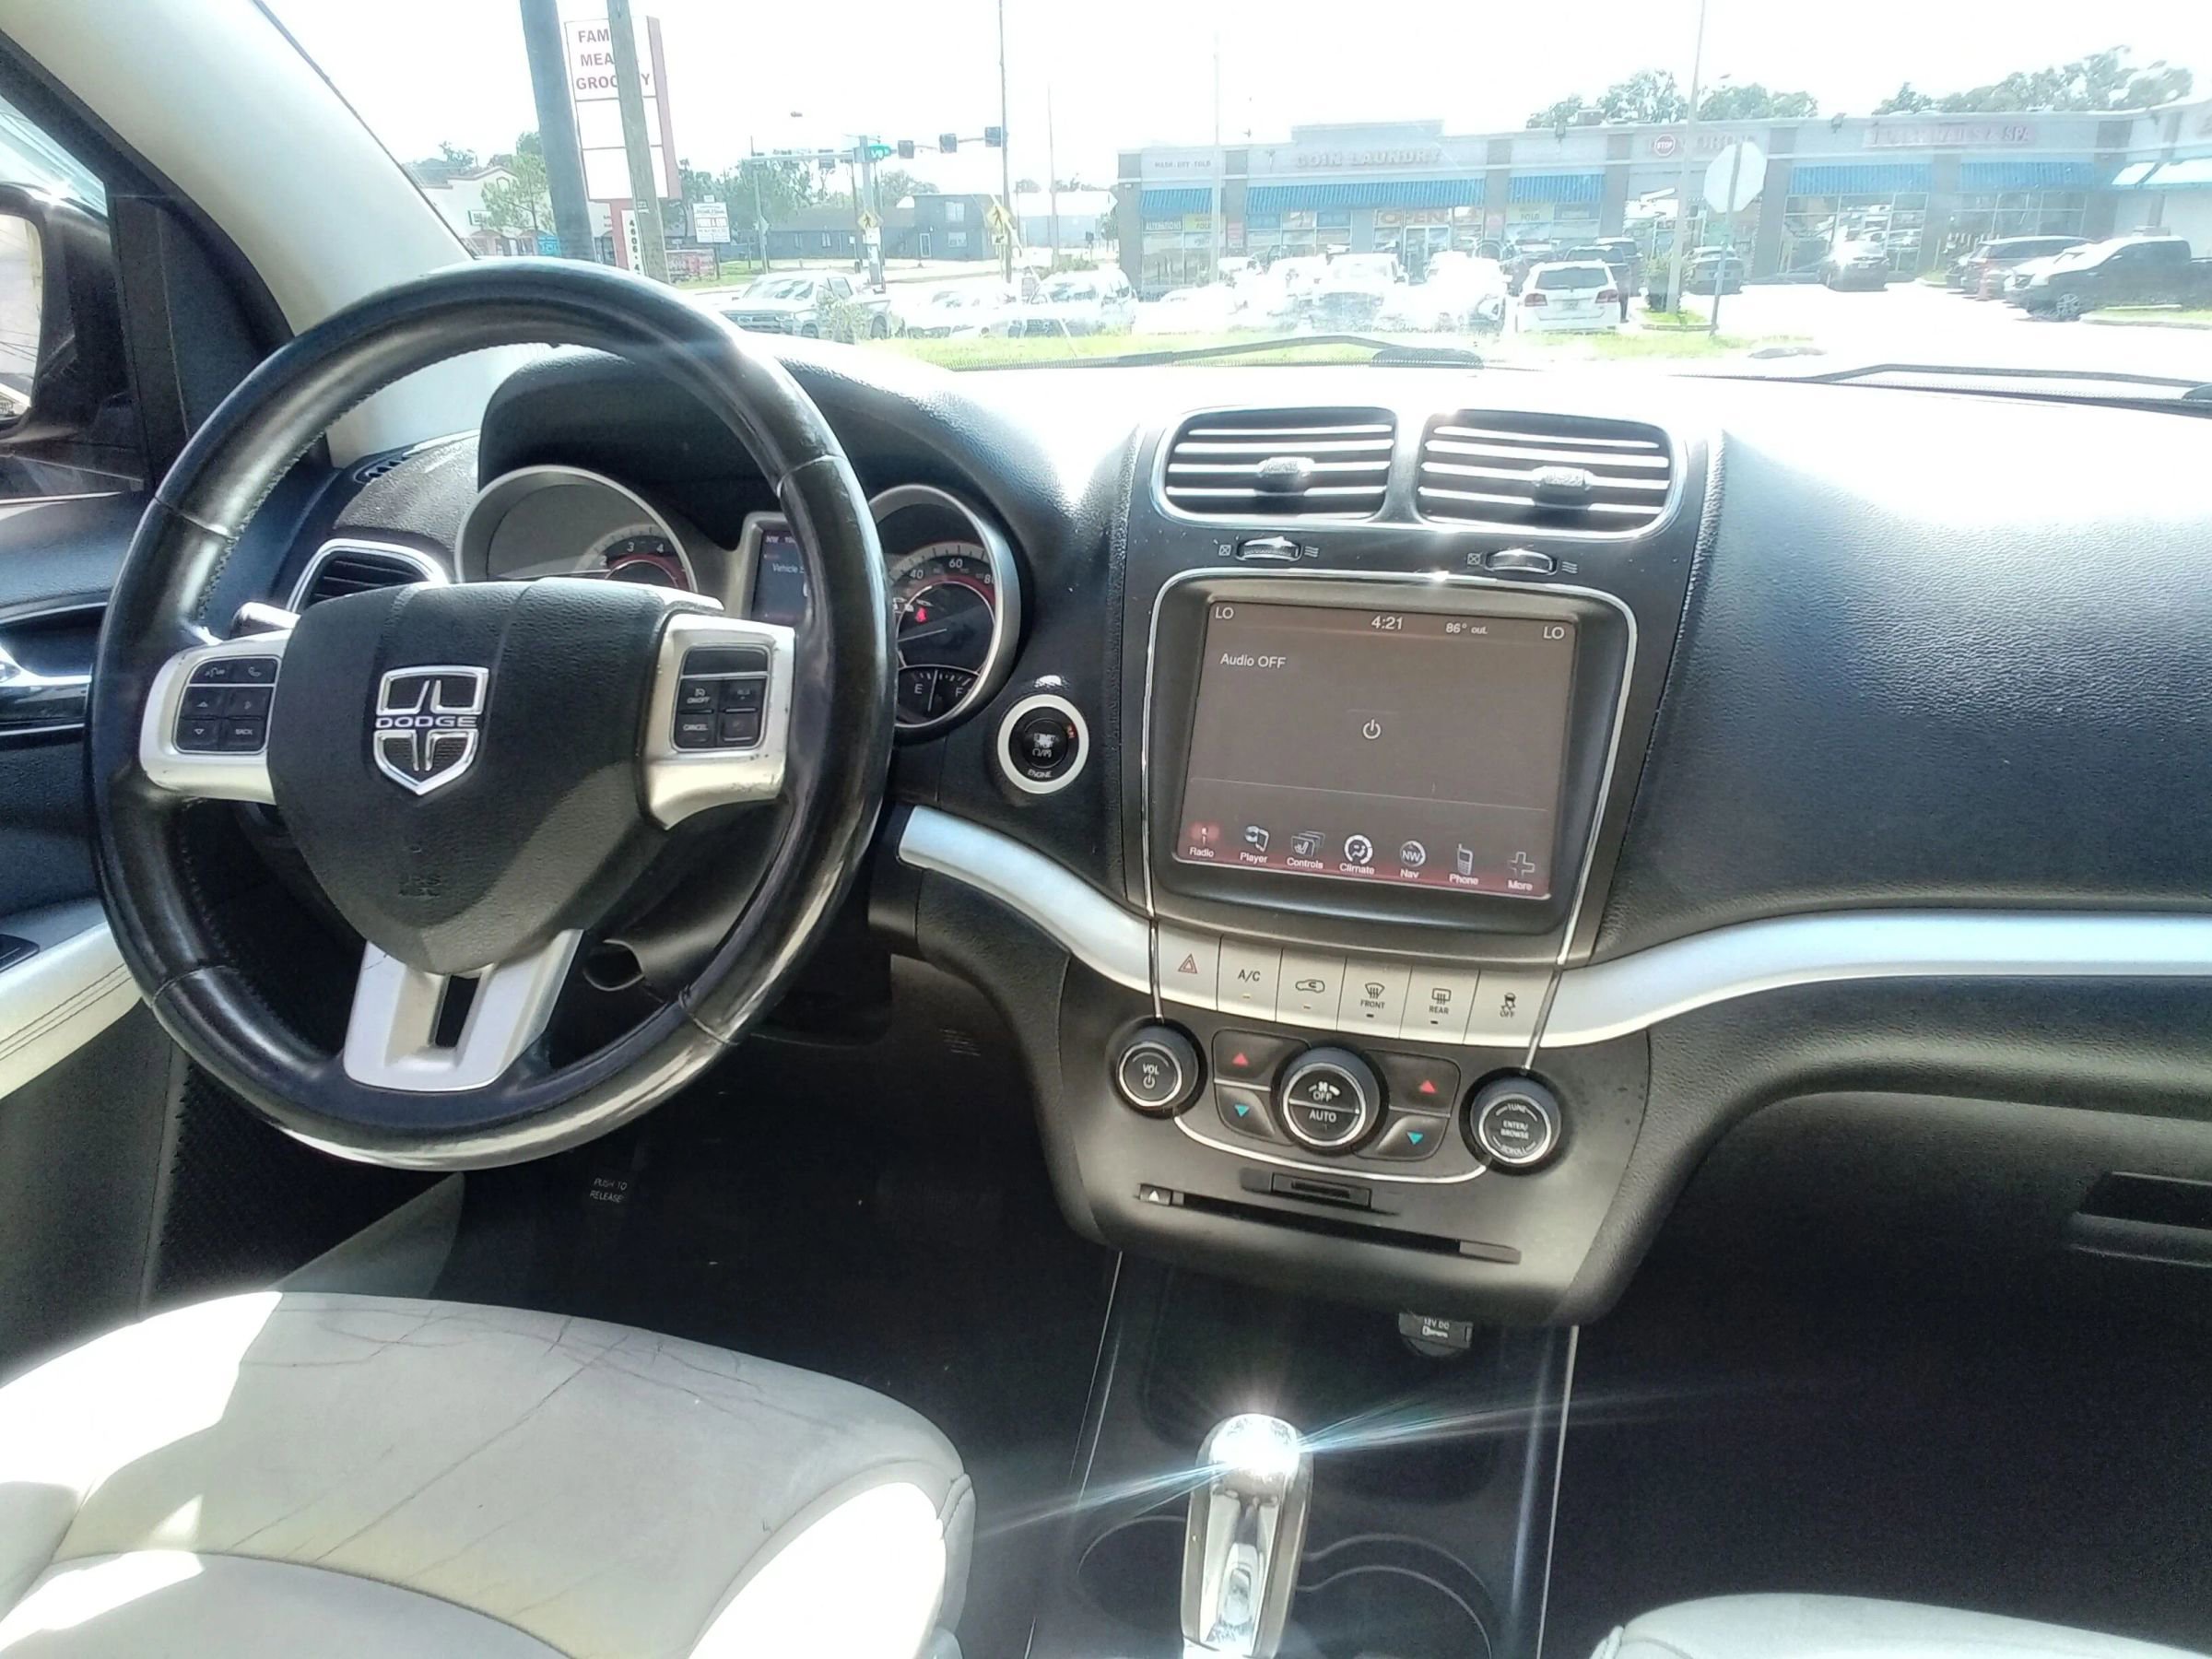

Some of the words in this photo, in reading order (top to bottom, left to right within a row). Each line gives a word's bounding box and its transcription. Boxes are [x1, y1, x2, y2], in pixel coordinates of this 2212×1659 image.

[578, 28, 609, 44] FAM
[580, 52, 614, 67] MEA
[627, 542, 635, 553] 3
[948, 559, 963, 569] 60
[910, 570, 924, 580] 40
[1215, 606, 1234, 619] LO
[1371, 616, 1404, 630] 4:21
[1543, 626, 1565, 640] LO
[1220, 653, 1254, 667] Audio
[1257, 655, 1286, 668] OFF
[914, 685, 924, 695] E
[956, 687, 964, 697] F
[375, 715, 478, 729] DODGE
[1189, 846, 1215, 858] Radio
[1401, 849, 1421, 861] NW
[1240, 852, 1268, 865] Player
[1286, 856, 1324, 870] Controls
[1339, 862, 1375, 875] Climate
[1400, 868, 1419, 878] Nav
[1449, 873, 1479, 886] Phone
[1508, 879, 1533, 890] More
[1238, 969, 1261, 982] A/C
[1360, 1000, 1385, 1009] FRONT
[1429, 1006, 1450, 1015] REAR
[1142, 1064, 1159, 1076] VOL
[1312, 1090, 1332, 1102] OFF
[1309, 1111, 1336, 1124] AUTO
